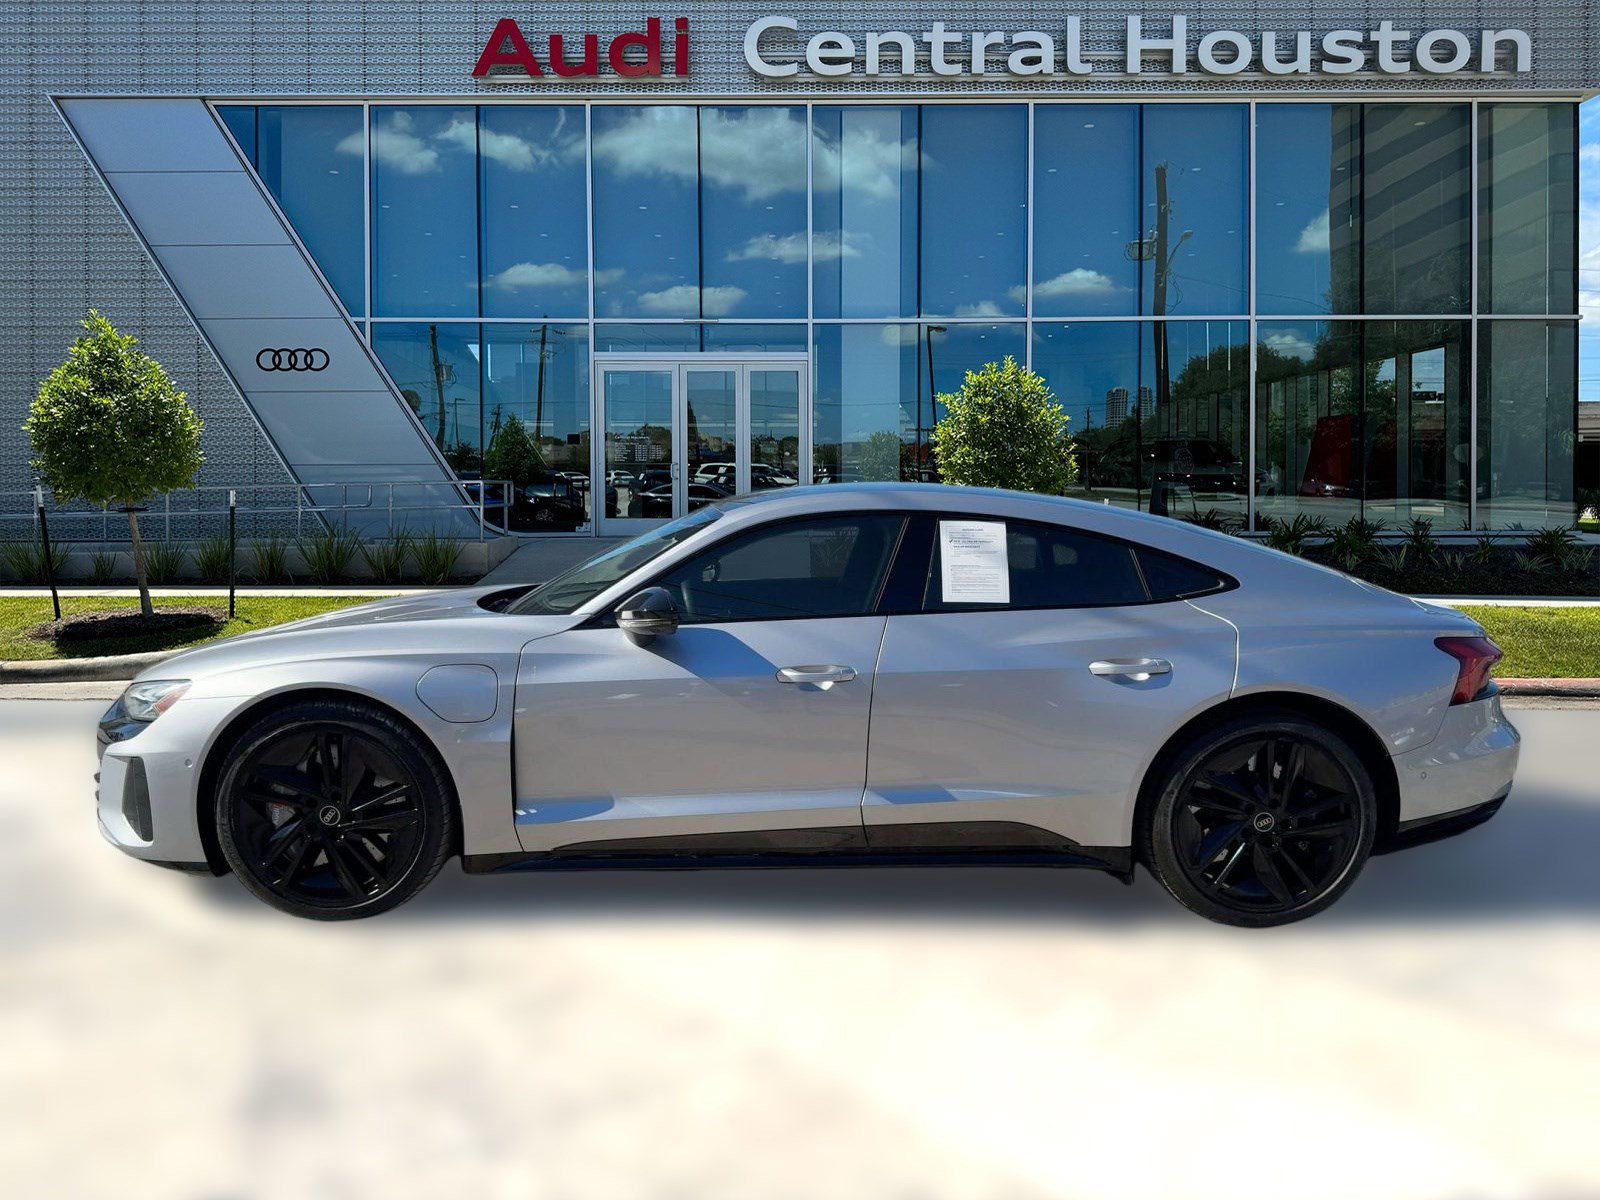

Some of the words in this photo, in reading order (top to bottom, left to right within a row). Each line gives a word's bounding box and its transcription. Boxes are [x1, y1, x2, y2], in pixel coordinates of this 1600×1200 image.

[471, 16, 690, 78] Audi
[743, 15, 1092, 78] Central
[1126, 15, 1532, 76] Houston
